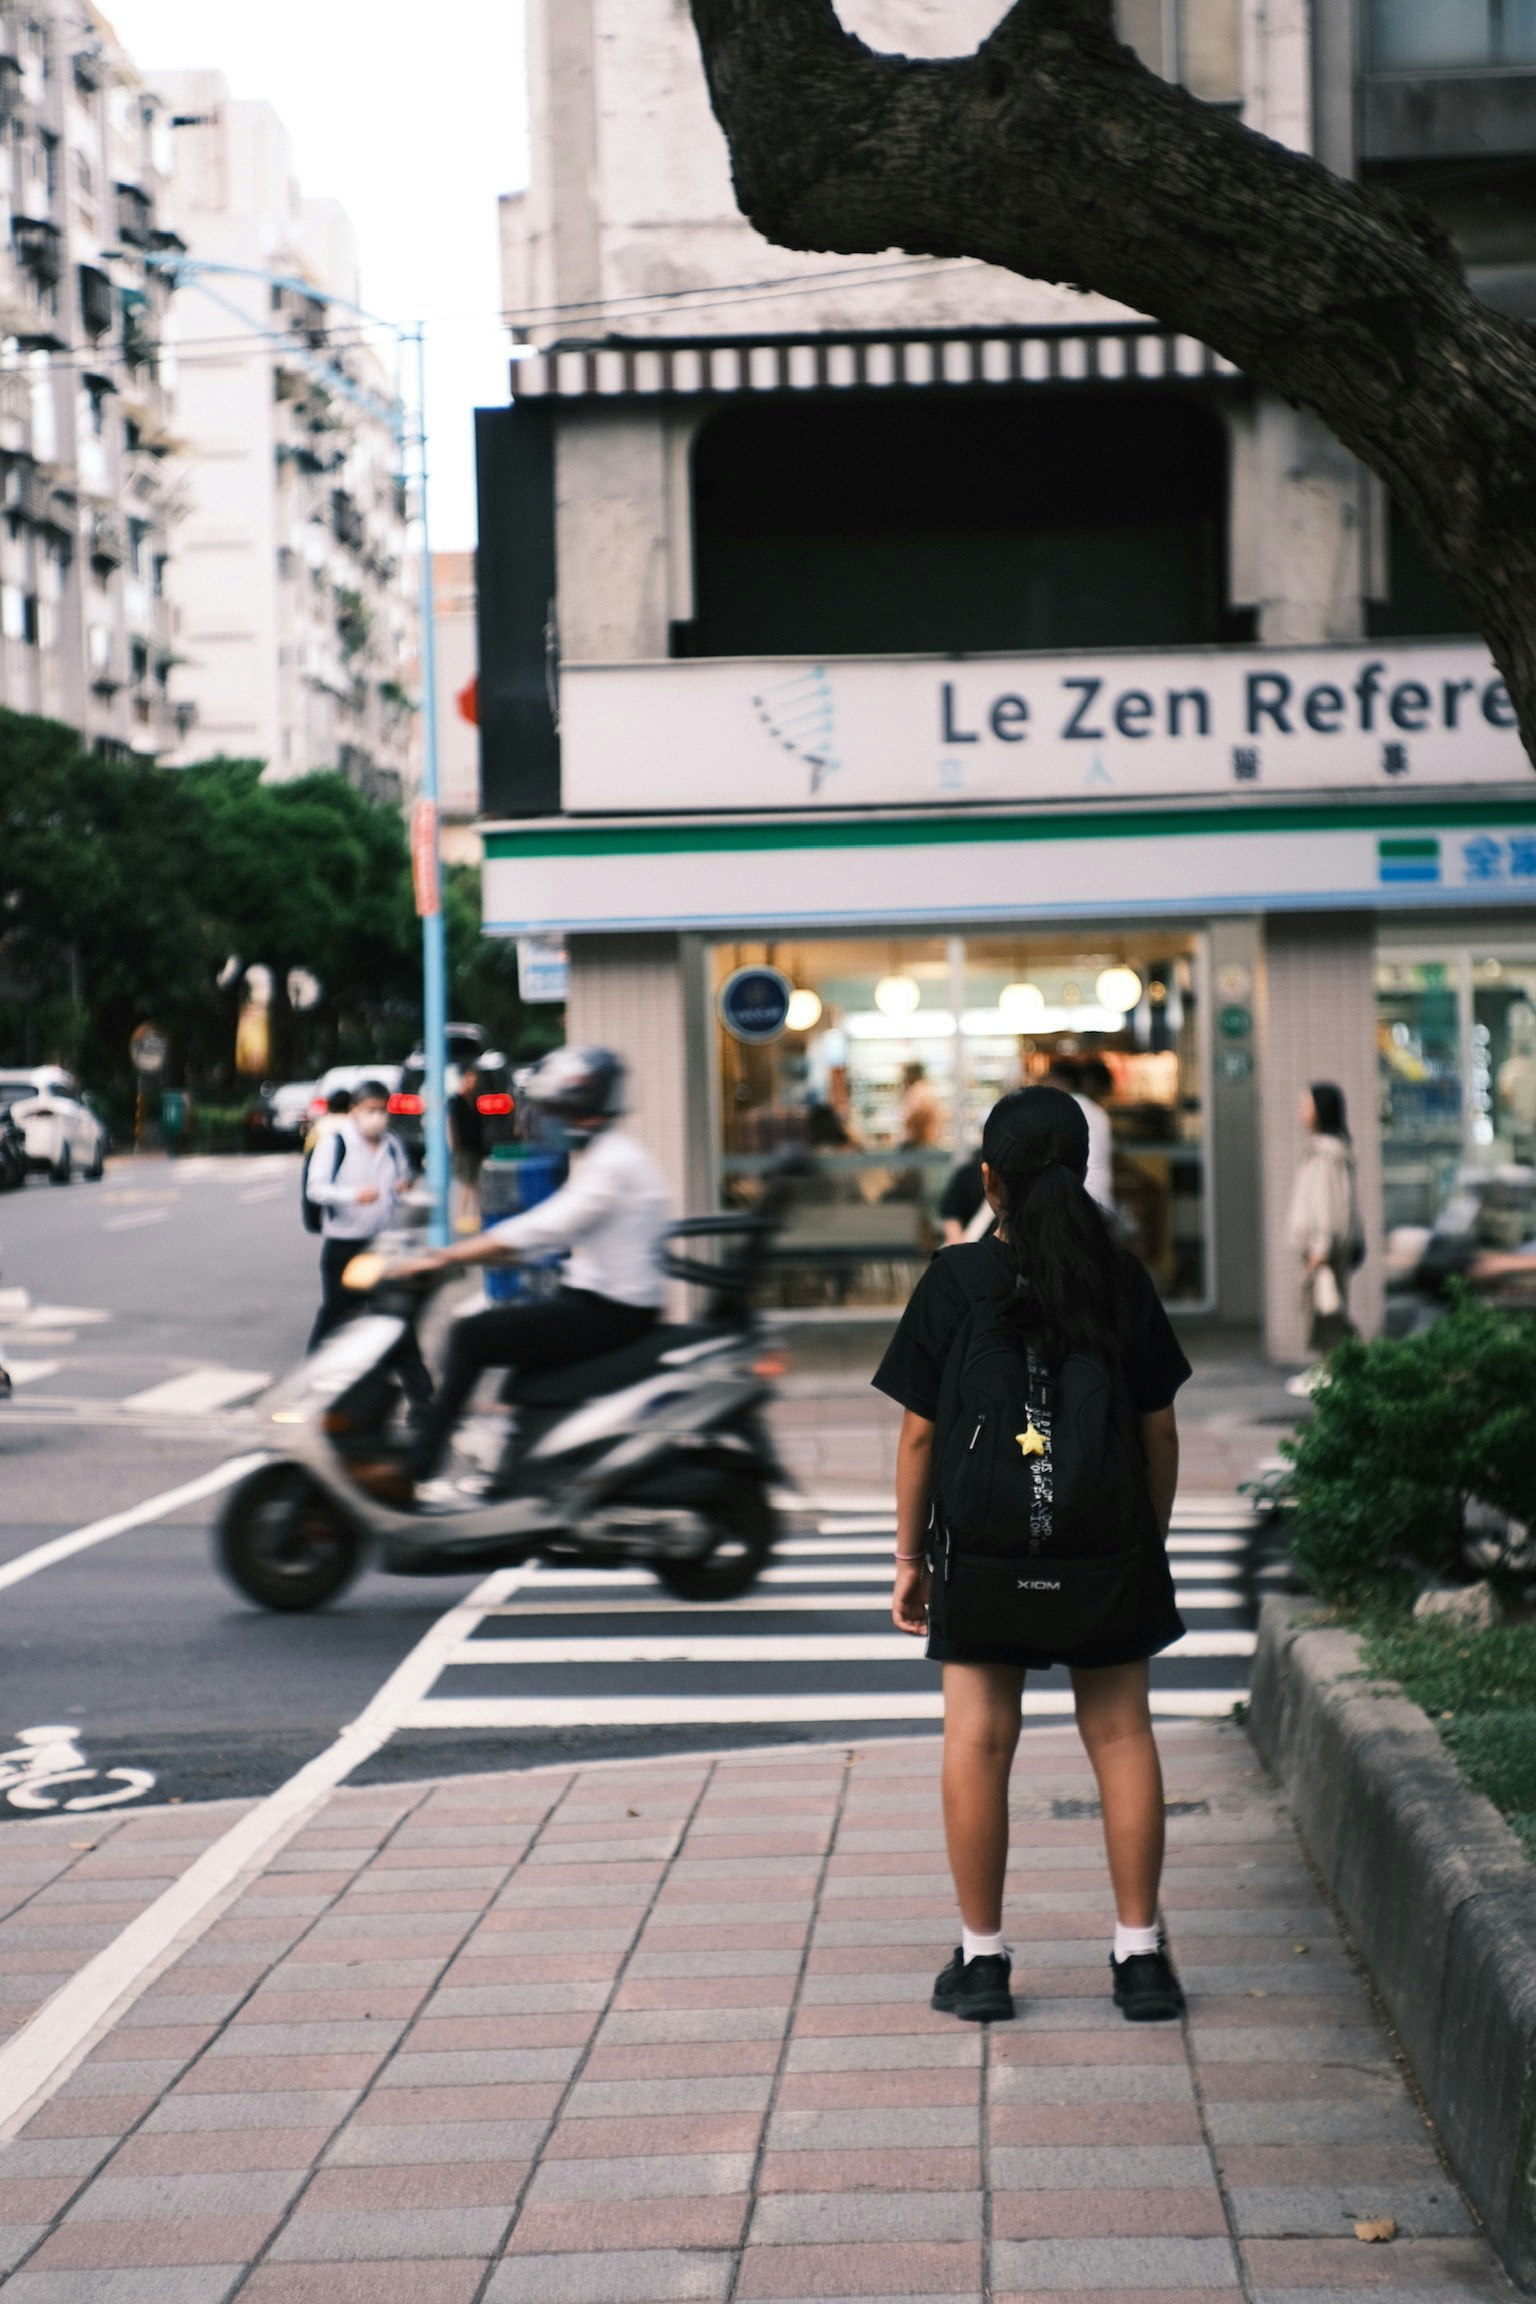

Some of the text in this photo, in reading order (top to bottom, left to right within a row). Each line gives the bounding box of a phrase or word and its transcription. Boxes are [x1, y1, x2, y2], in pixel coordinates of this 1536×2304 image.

[942, 683, 1029, 743] Le
[1062, 678, 1210, 740] Zen
[1016, 1580, 1061, 1591] XIOM
